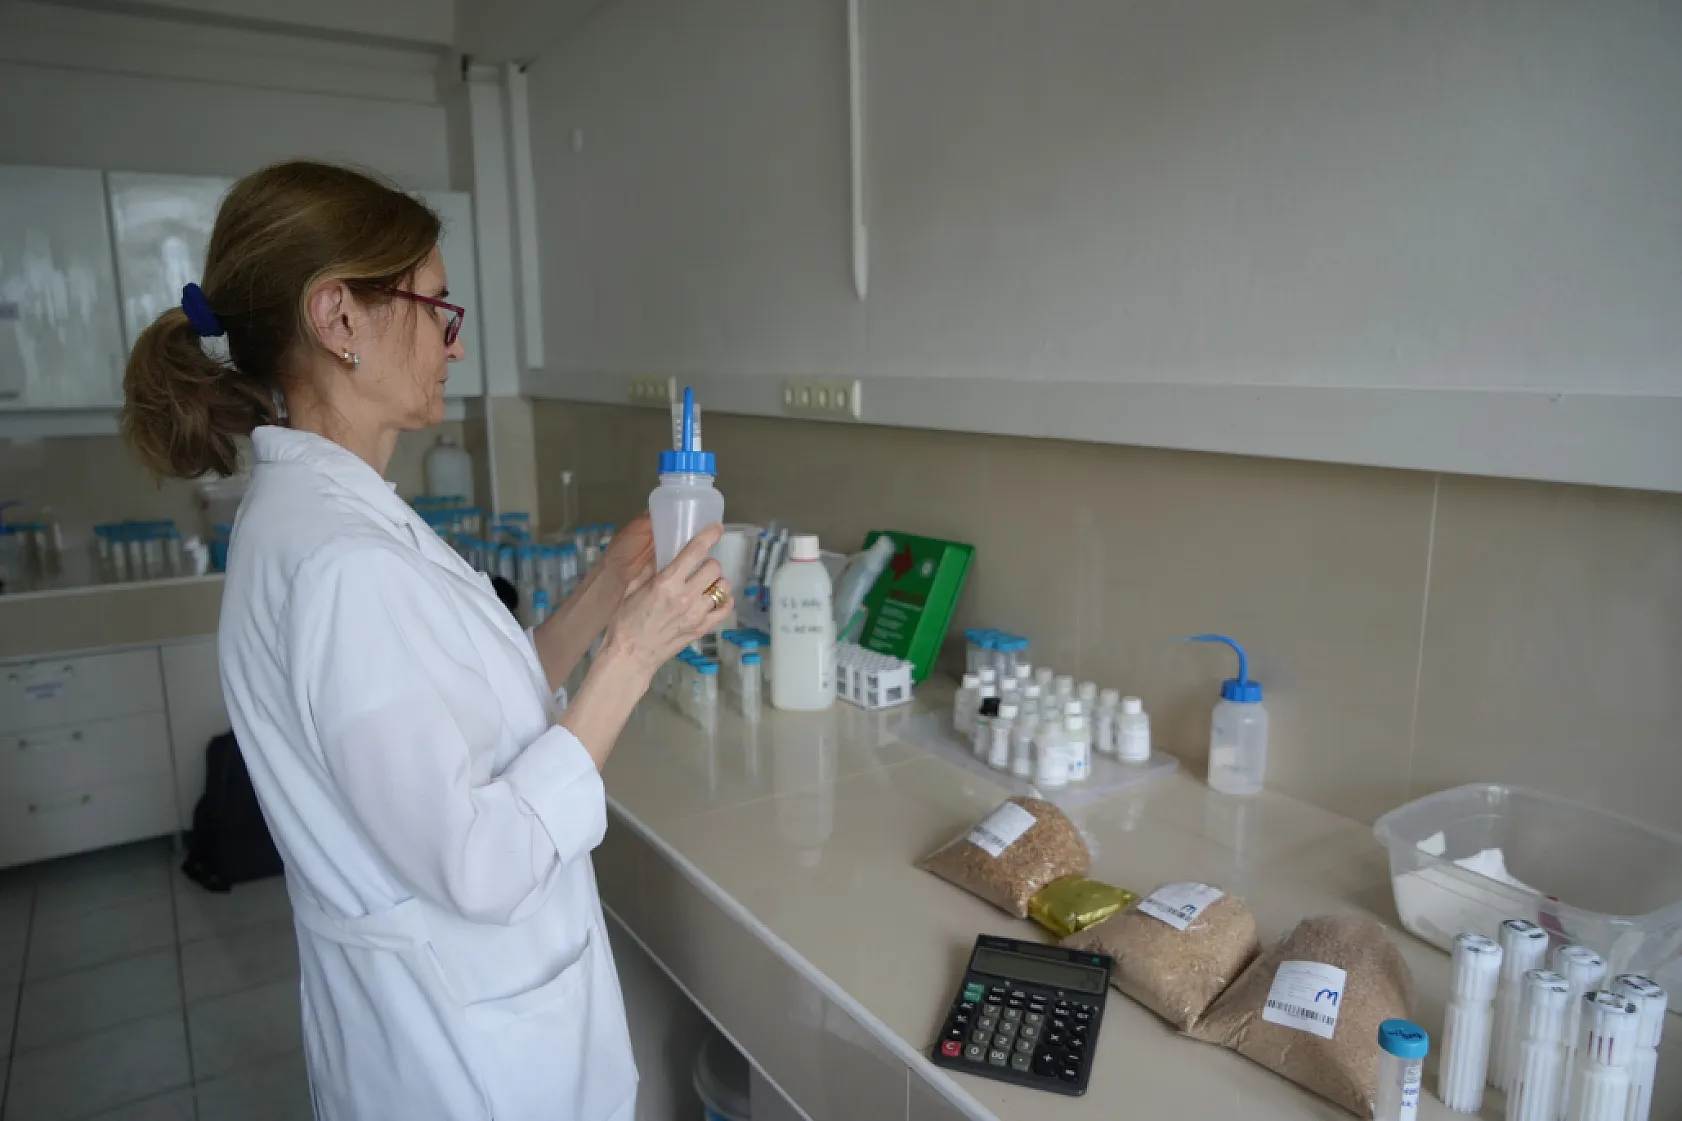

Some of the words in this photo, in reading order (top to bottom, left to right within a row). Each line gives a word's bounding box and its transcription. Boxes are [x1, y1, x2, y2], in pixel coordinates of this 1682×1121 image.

[946, 1042, 956, 1050] C
[970, 1046, 980, 1055] 0
[991, 1050, 1005, 1060] 00
